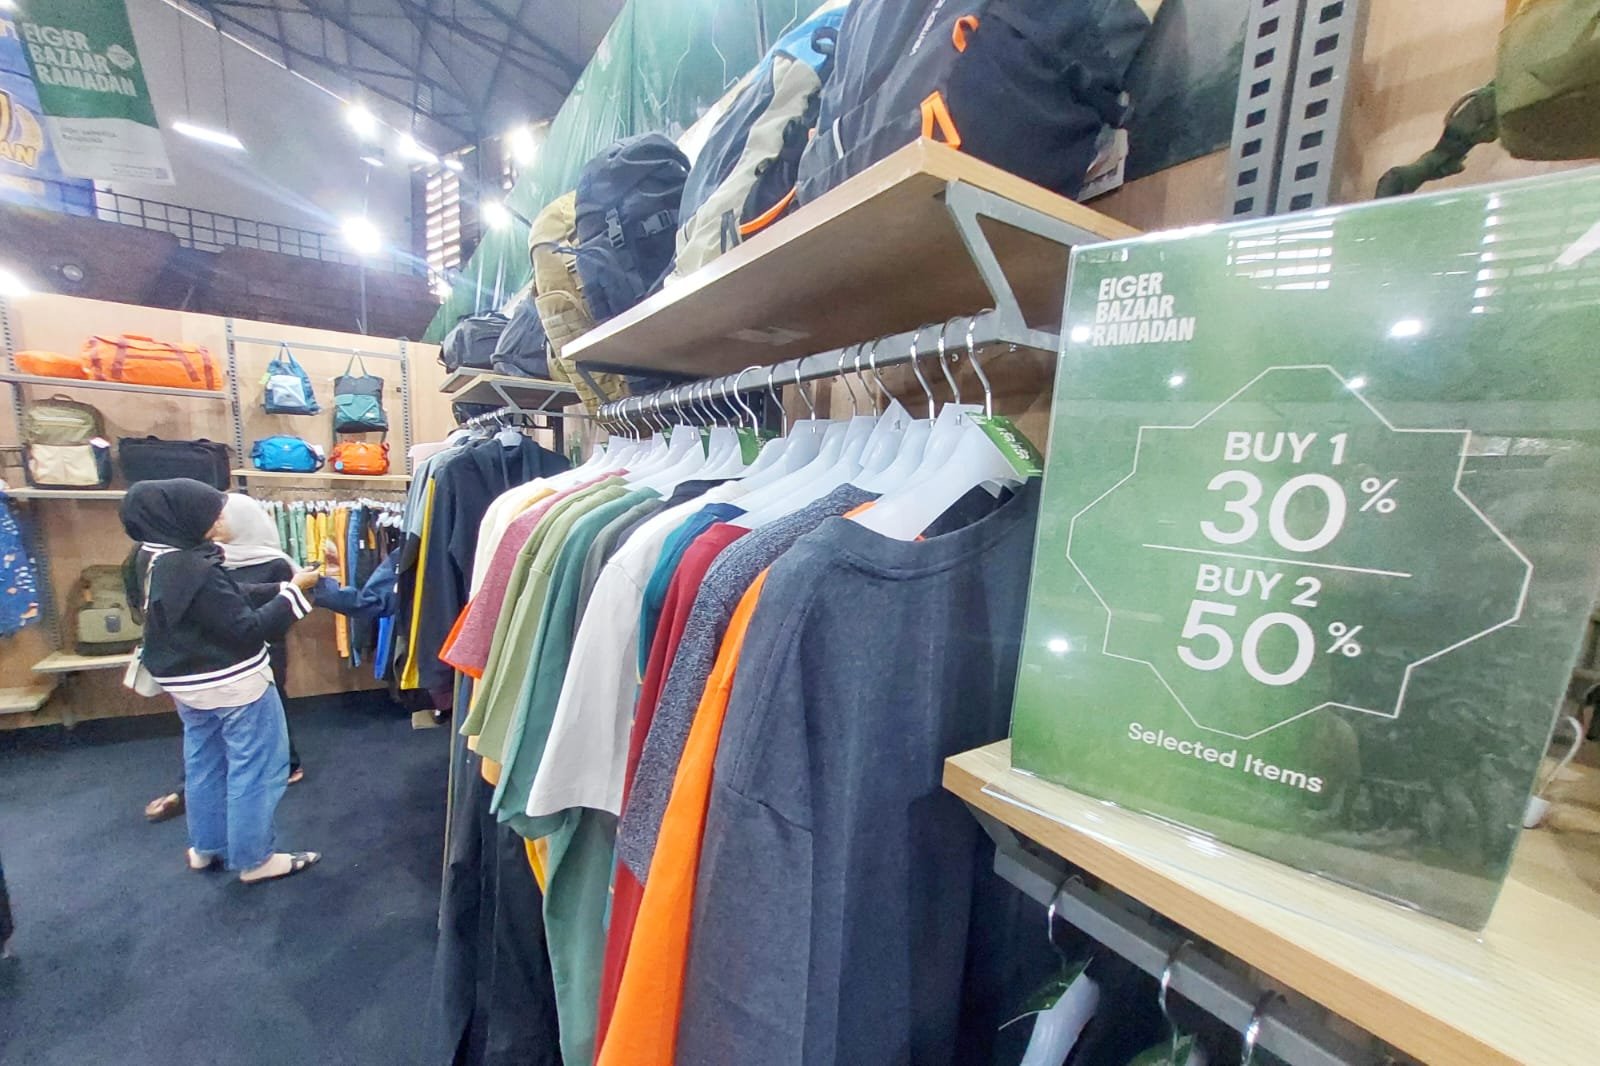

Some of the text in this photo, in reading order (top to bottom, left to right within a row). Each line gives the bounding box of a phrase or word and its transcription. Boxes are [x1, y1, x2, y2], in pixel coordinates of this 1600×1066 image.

[22, 22, 91, 51] EIGER
[28, 43, 111, 74] BAZAAR
[35, 64, 137, 97] RAMADAN
[1098, 271, 1164, 301] EIGER
[1095, 294, 1175, 324] BAZAAR
[1092, 316, 1196, 347] RAMADAN
[1224, 431, 1348, 465] BUY 1
[1195, 563, 1322, 607] BUY 2
[1127, 722, 1324, 793] Selected Items
